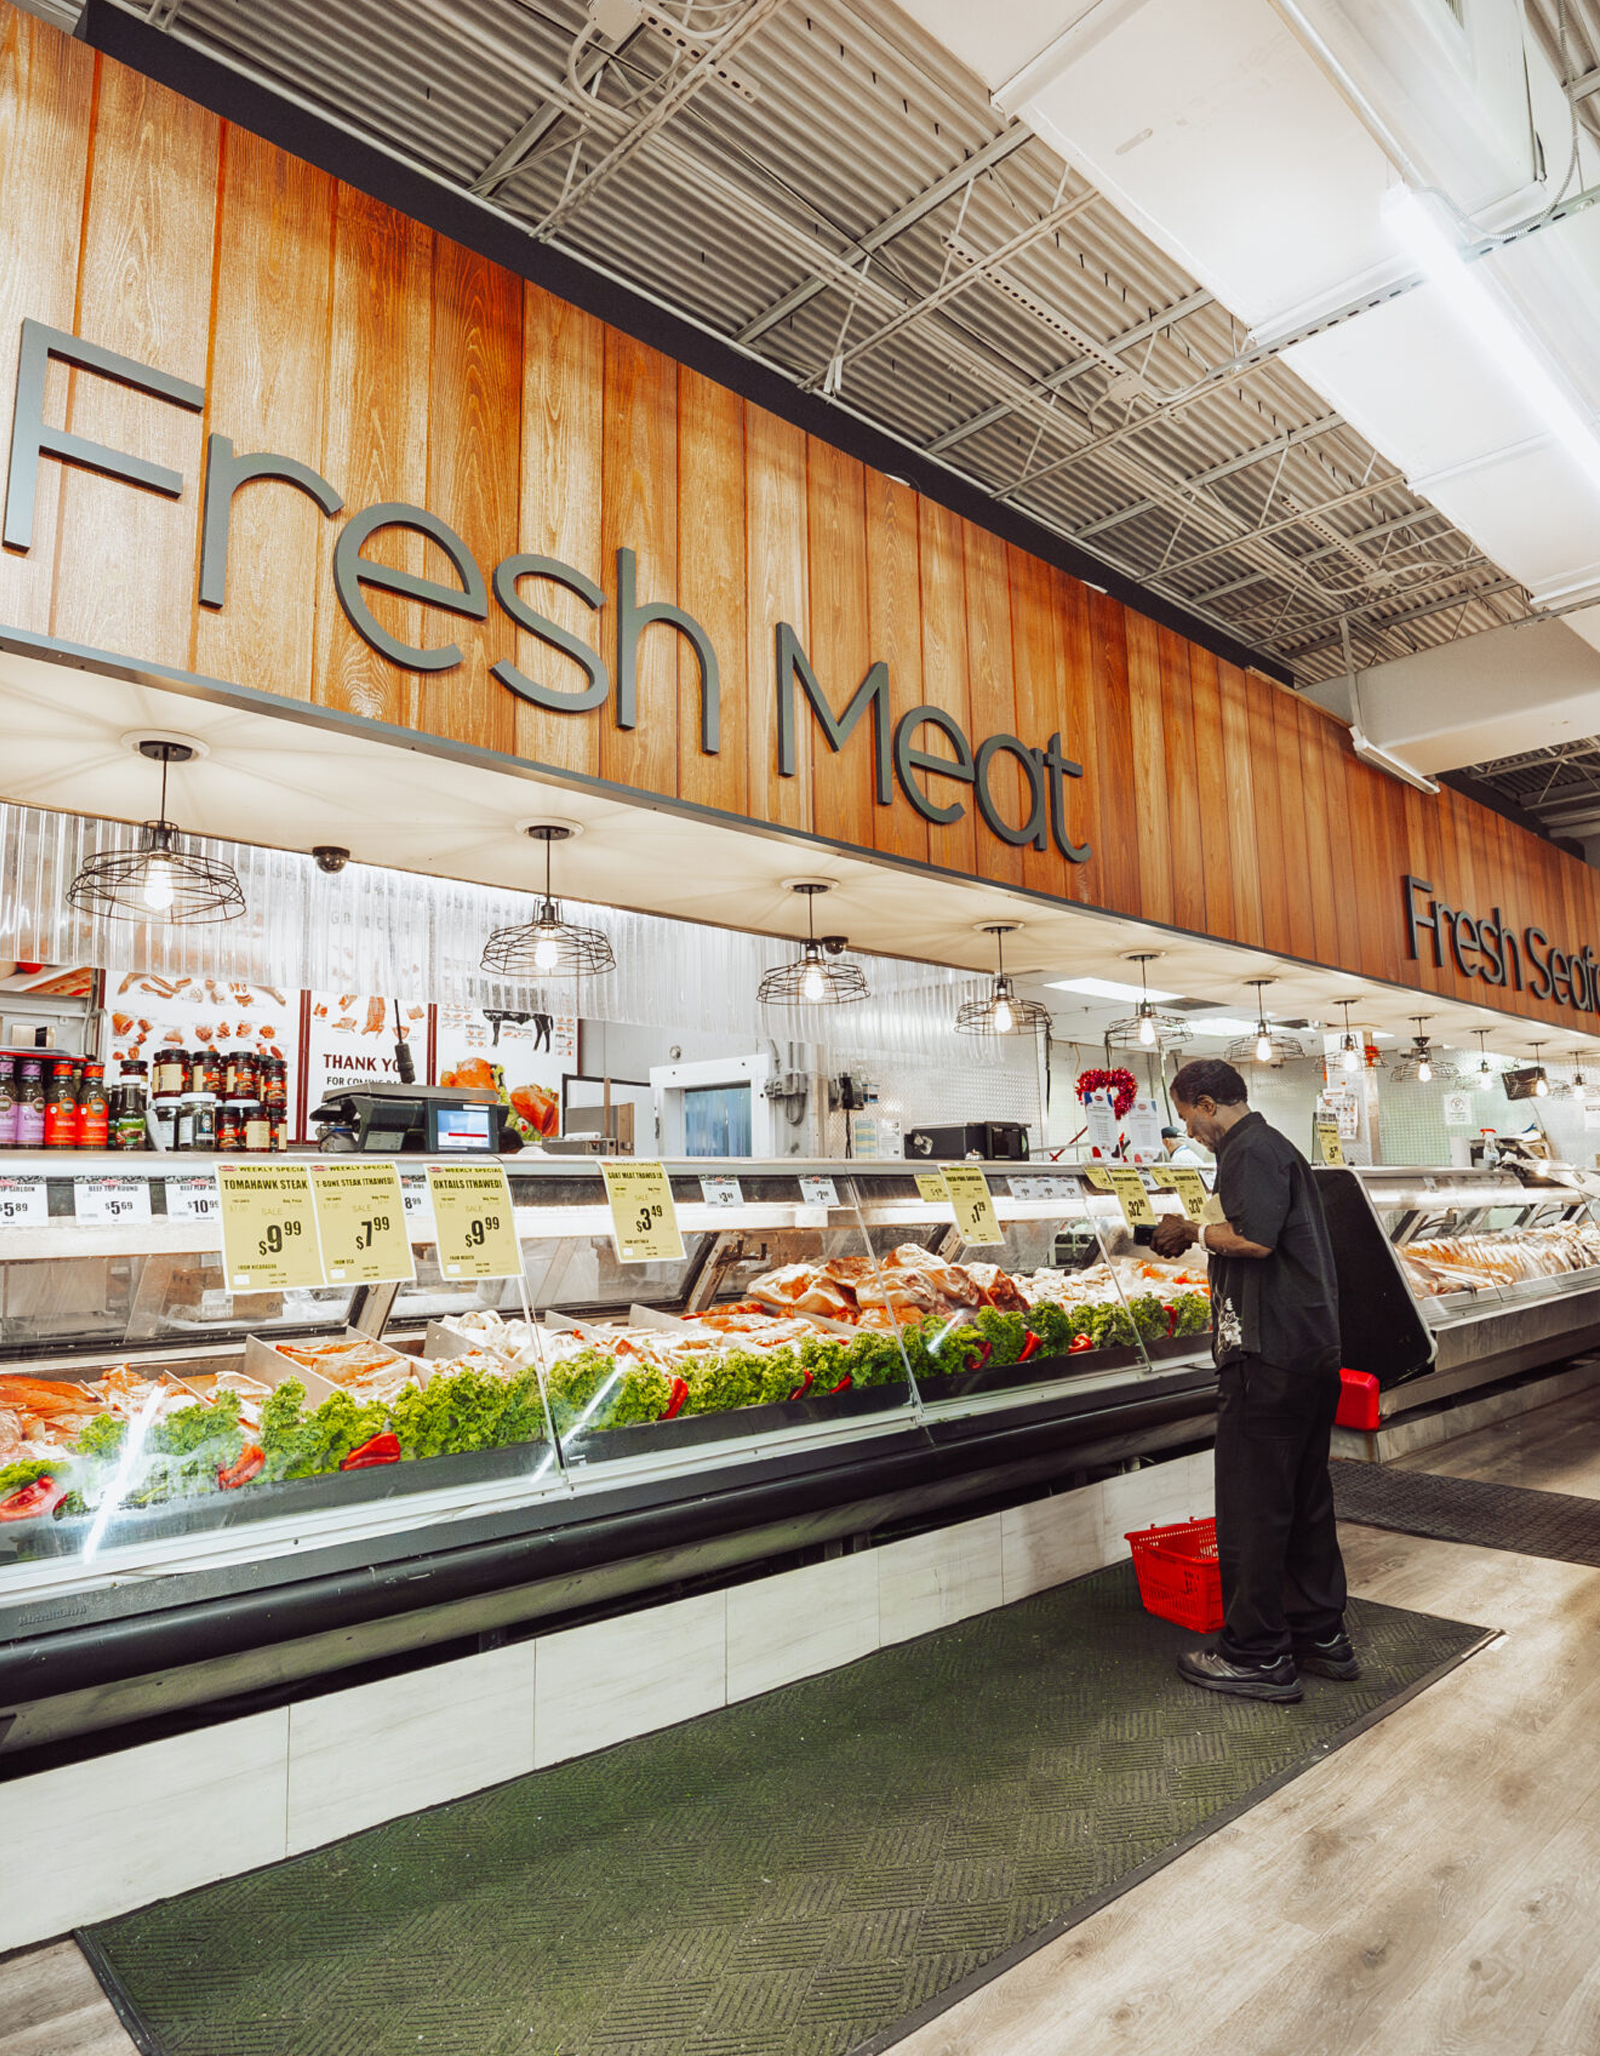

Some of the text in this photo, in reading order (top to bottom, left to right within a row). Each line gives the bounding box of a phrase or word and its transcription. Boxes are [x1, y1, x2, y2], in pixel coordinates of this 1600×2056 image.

[2, 317, 1092, 864] Fresh Meat
[1403, 874, 1600, 1018] Fresh Seaf
[322, 1053, 400, 1074] THANK YO
[326, 1075, 345, 1086] FOR
[223, 1179, 308, 1190] TOMAHAWK STEAK
[341, 1178, 362, 1187] STEAK
[433, 1179, 465, 1189] OXTAILS
